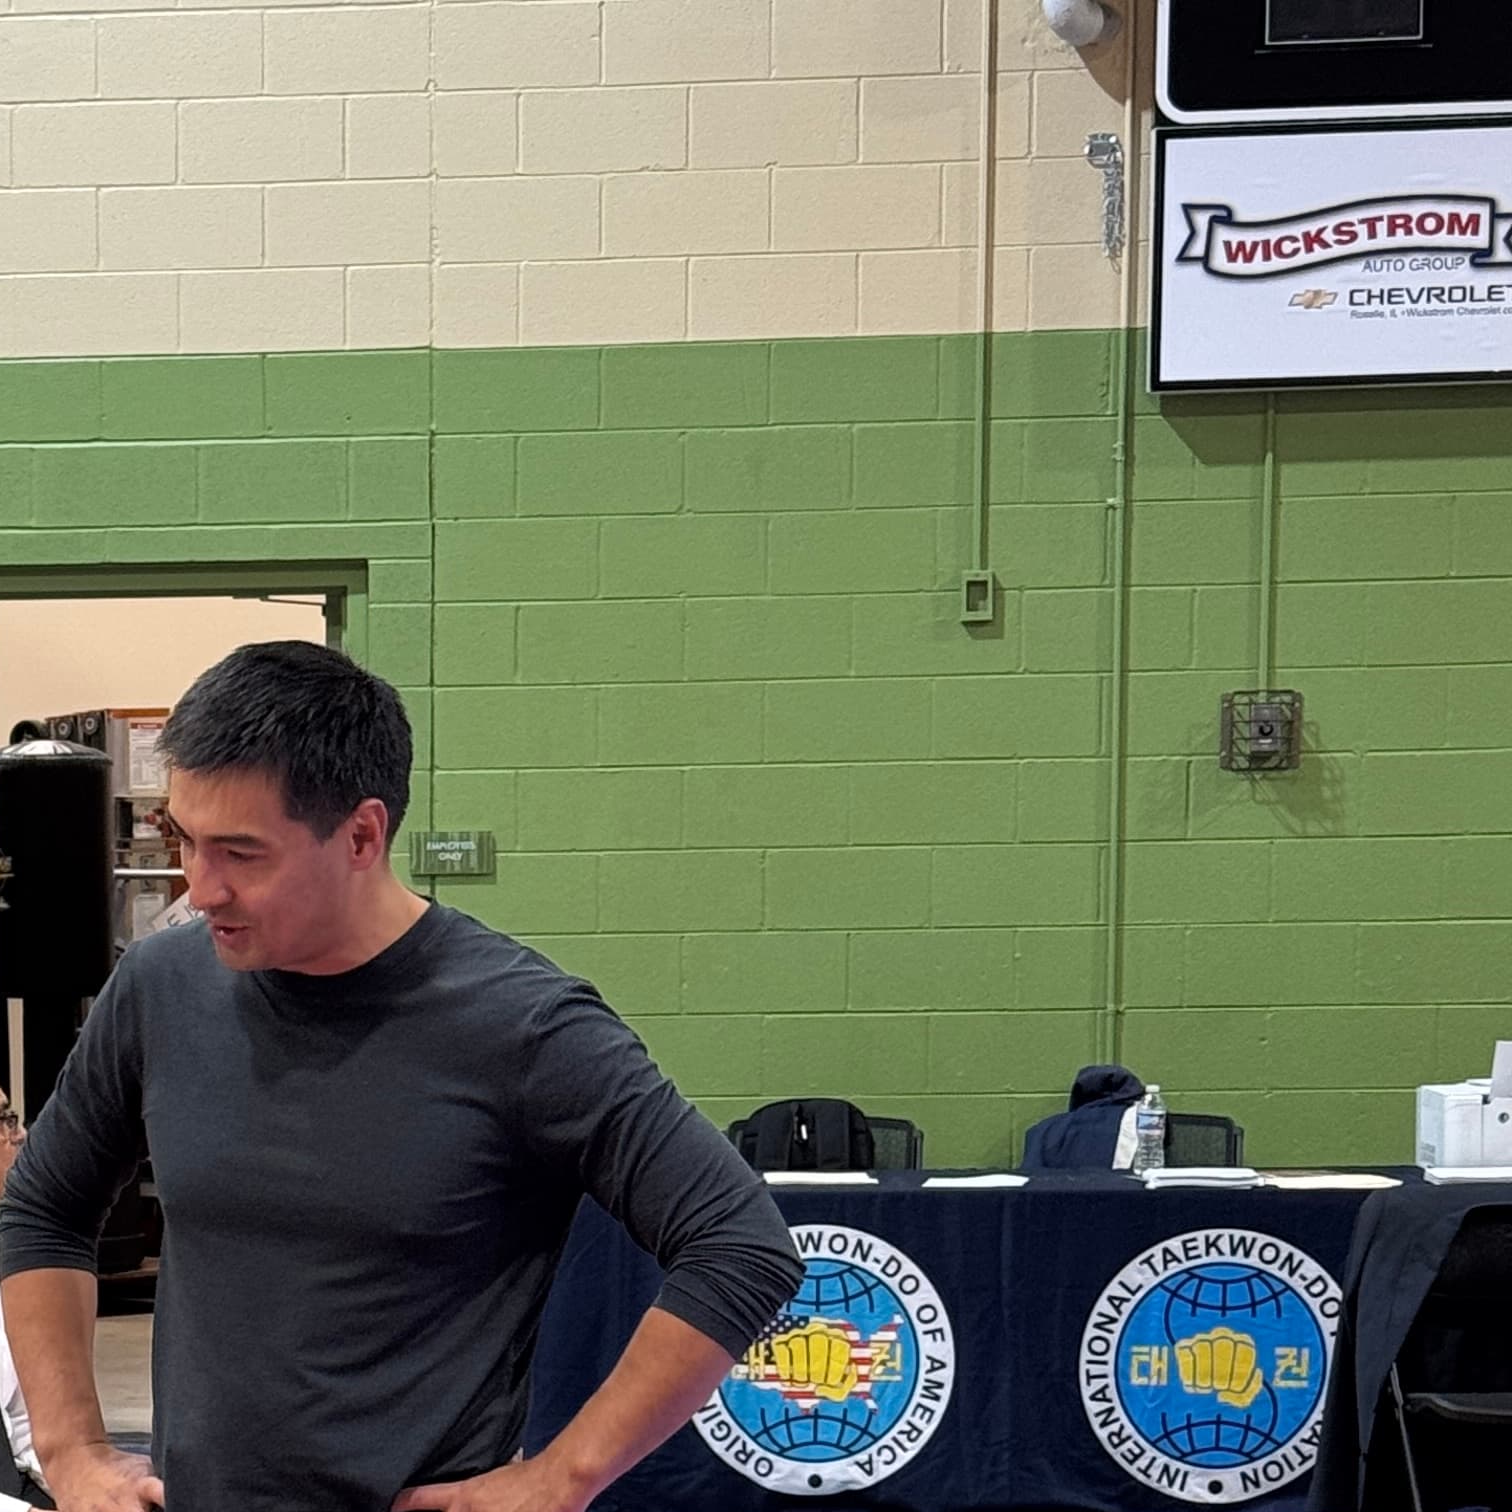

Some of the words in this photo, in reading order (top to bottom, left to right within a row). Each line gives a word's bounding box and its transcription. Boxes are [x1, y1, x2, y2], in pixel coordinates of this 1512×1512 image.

[1223, 211, 1481, 264] WICKSTROM
[1361, 257, 1405, 274] AUTO
[1408, 255, 1466, 272] GROUP
[915, 1303, 946, 1343] OF
[1085, 1281, 1191, 1493] INTERNATIONAL
[1138, 1233, 1340, 1320] TAEKWON-DO
[854, 1354, 947, 1478] AMERICA
